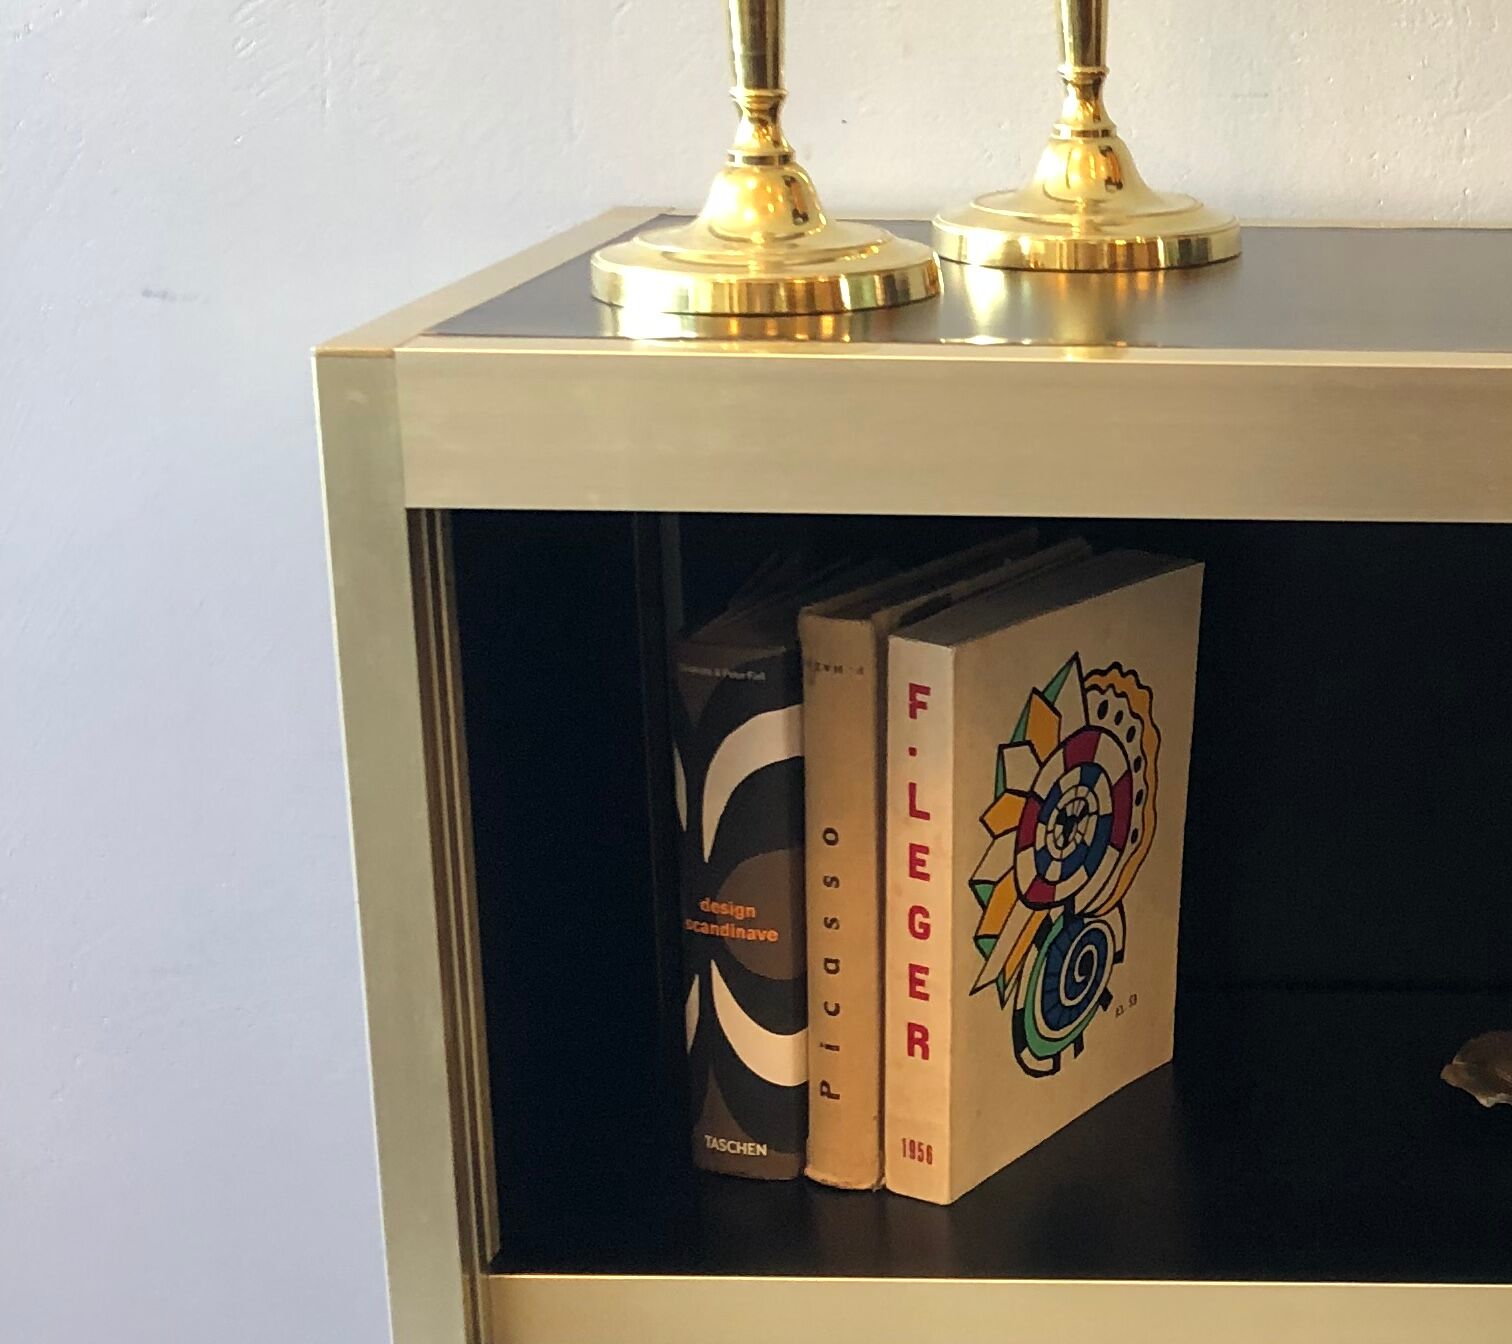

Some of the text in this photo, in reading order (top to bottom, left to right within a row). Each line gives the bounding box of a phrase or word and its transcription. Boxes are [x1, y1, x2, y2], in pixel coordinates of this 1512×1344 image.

[700, 897, 756, 920] design
[685, 919, 779, 942] scandinave
[819, 827, 842, 1101] Picasso
[704, 1134, 768, 1157] TASCHEN
[902, 1137, 933, 1166] 1956
